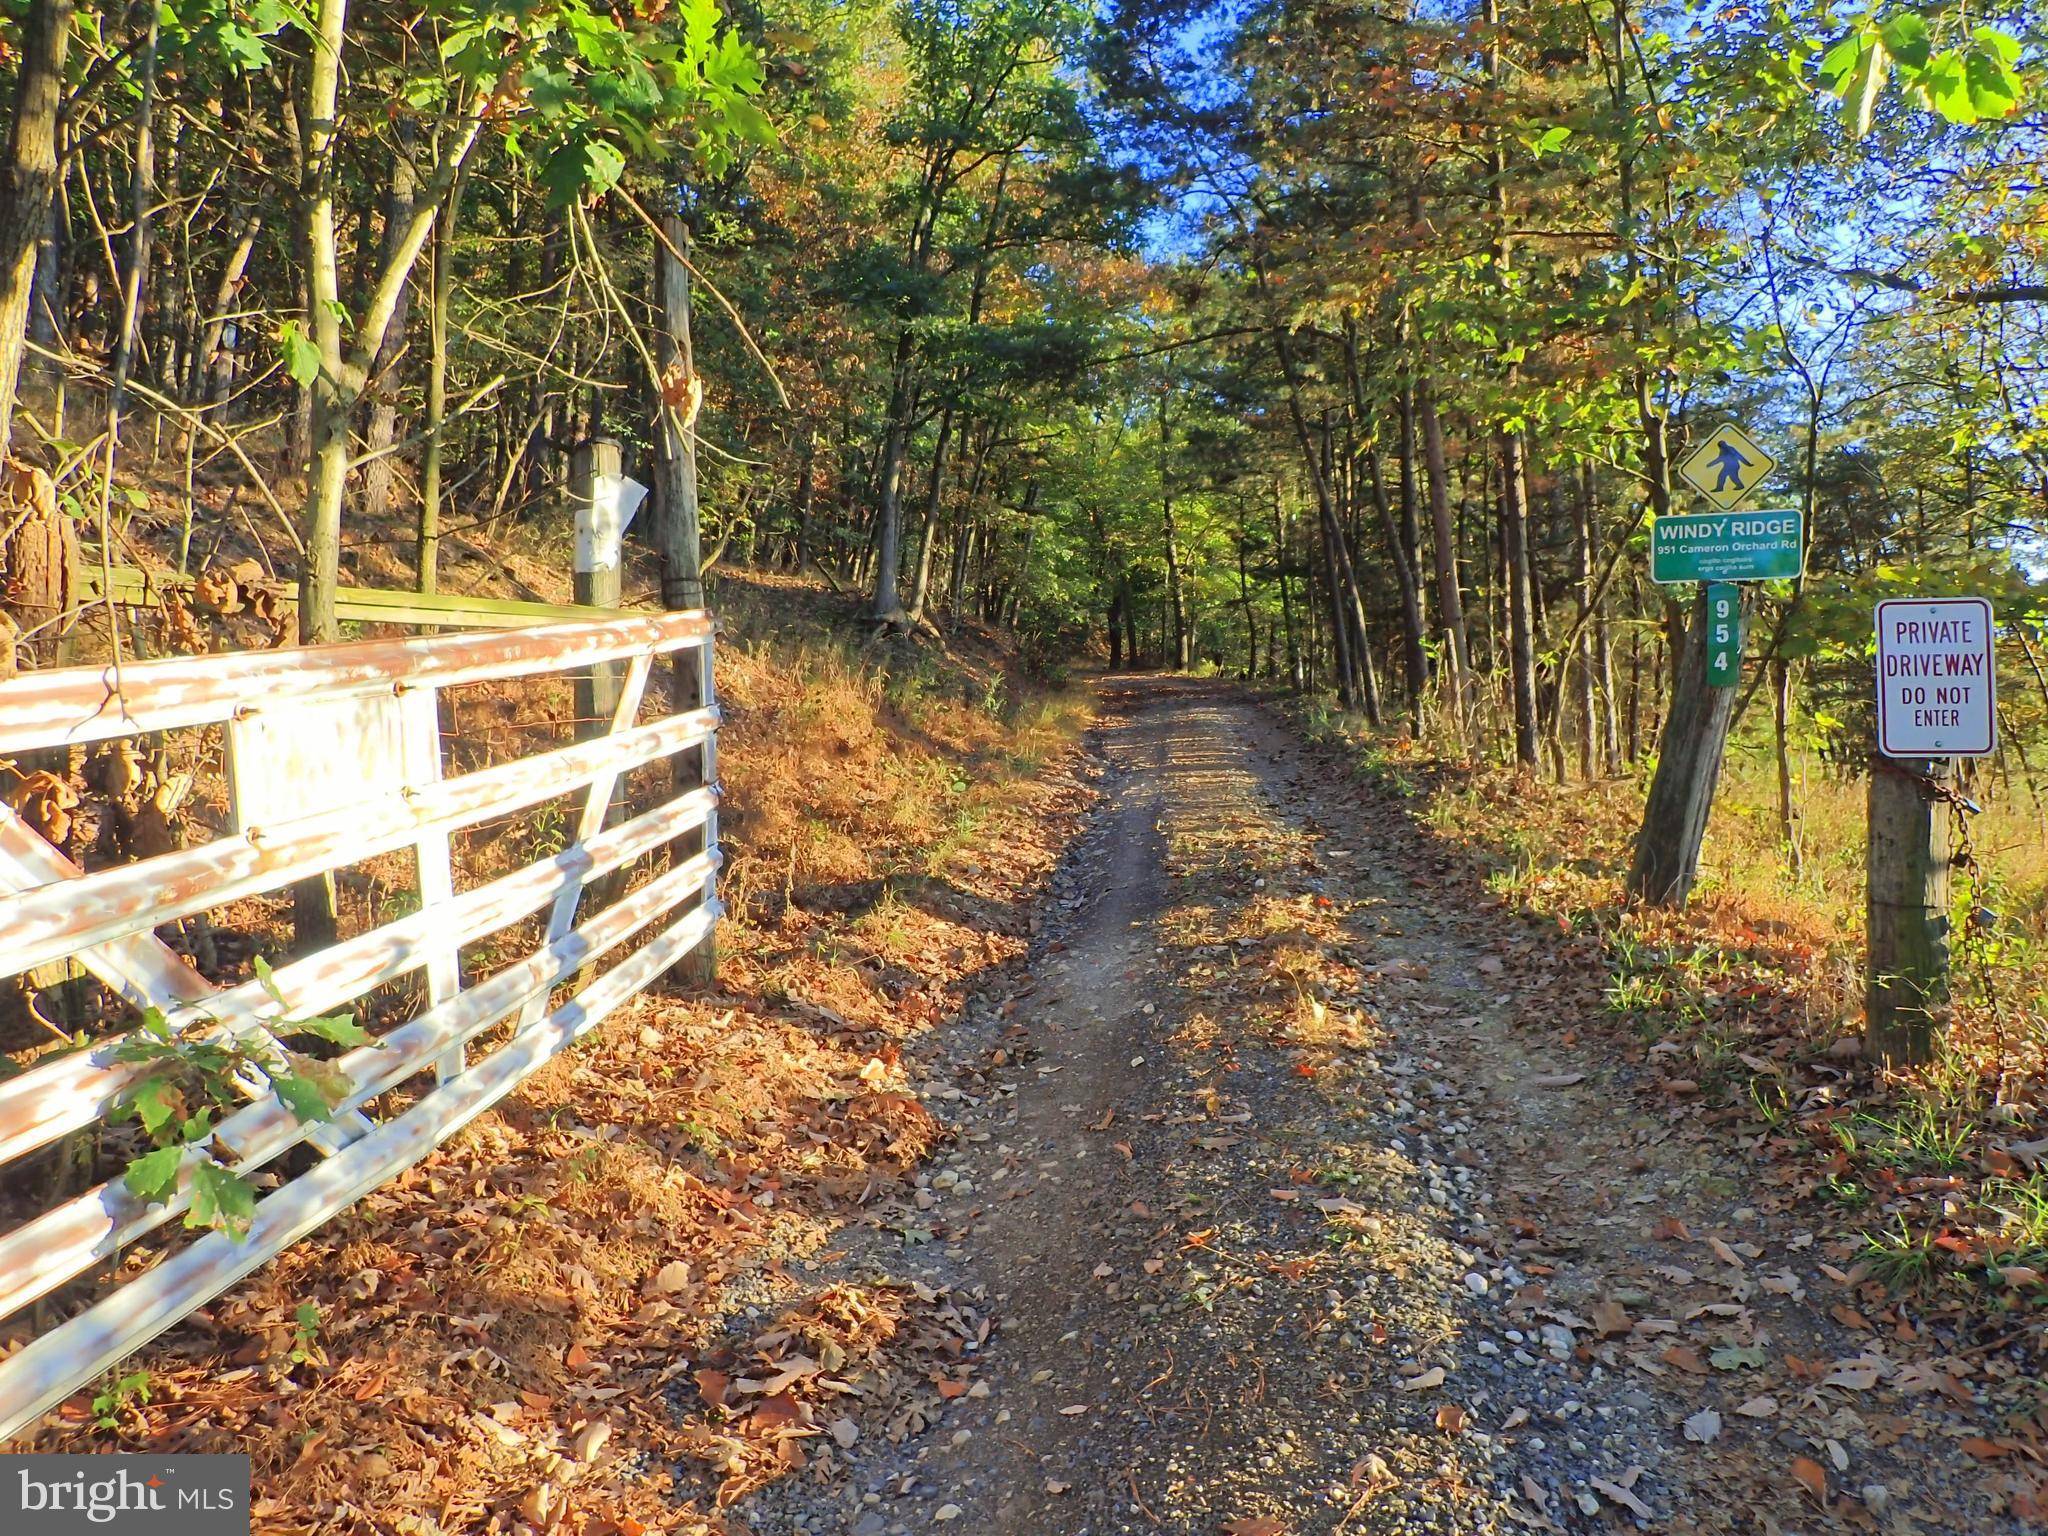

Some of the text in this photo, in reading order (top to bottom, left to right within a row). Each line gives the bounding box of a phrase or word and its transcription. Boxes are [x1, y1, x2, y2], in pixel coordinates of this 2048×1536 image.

[1659, 519, 1796, 540] WINDY RIDGE
[1657, 539, 1797, 555] 951 Cameron Orchard Rd
[1714, 599, 1730, 671] 954
[1896, 620, 1973, 644] PRIVATE
[1886, 653, 1984, 677] DRIVEWAY
[1902, 686, 1971, 705] DO NOT
[1914, 709, 1960, 727] ENTER
